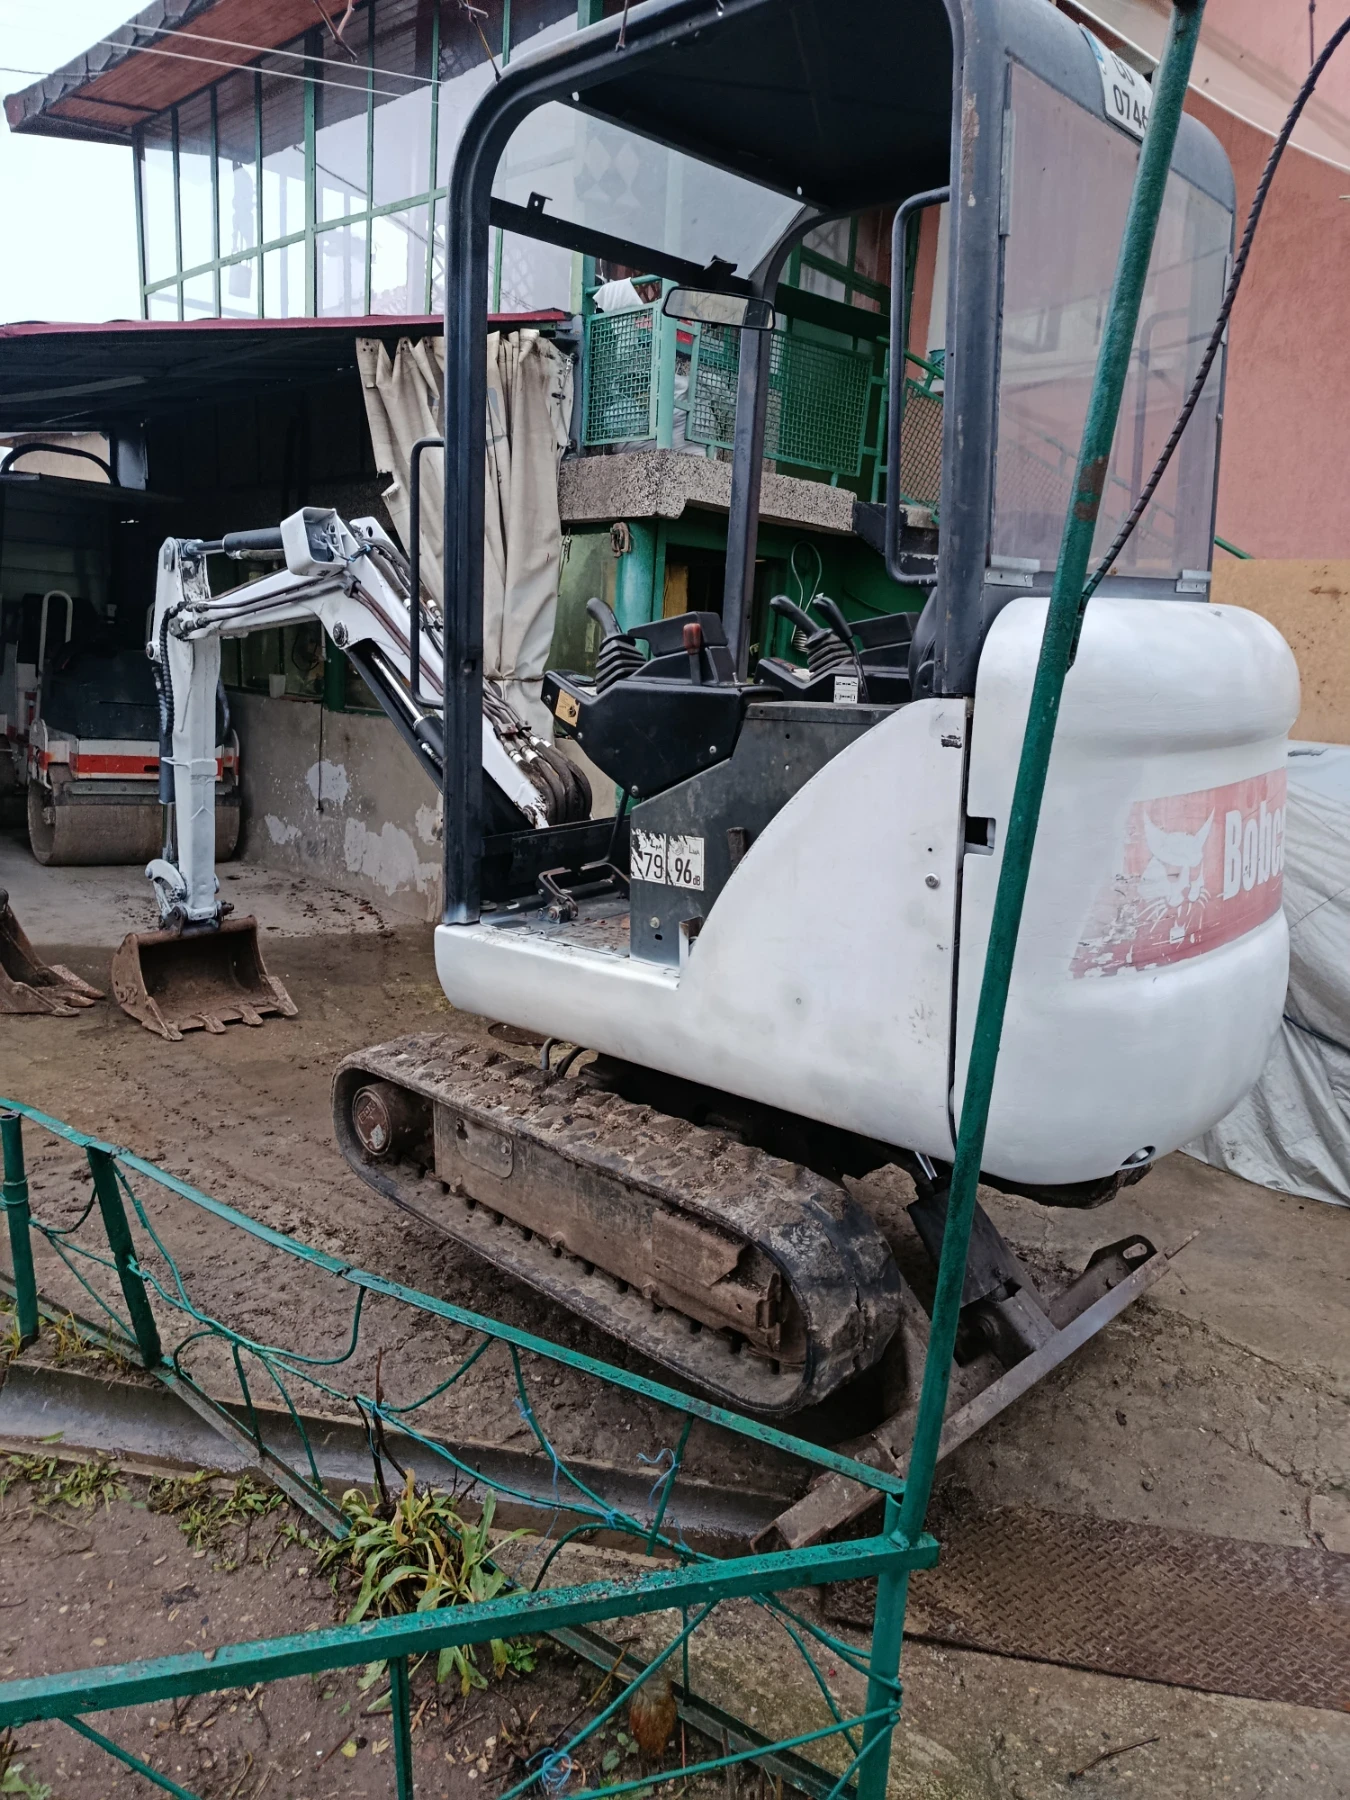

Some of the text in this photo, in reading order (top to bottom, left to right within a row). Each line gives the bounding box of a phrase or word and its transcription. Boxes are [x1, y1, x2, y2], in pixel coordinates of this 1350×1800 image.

[643, 852, 663, 879] 79
[675, 858, 701, 886] 96 dB
